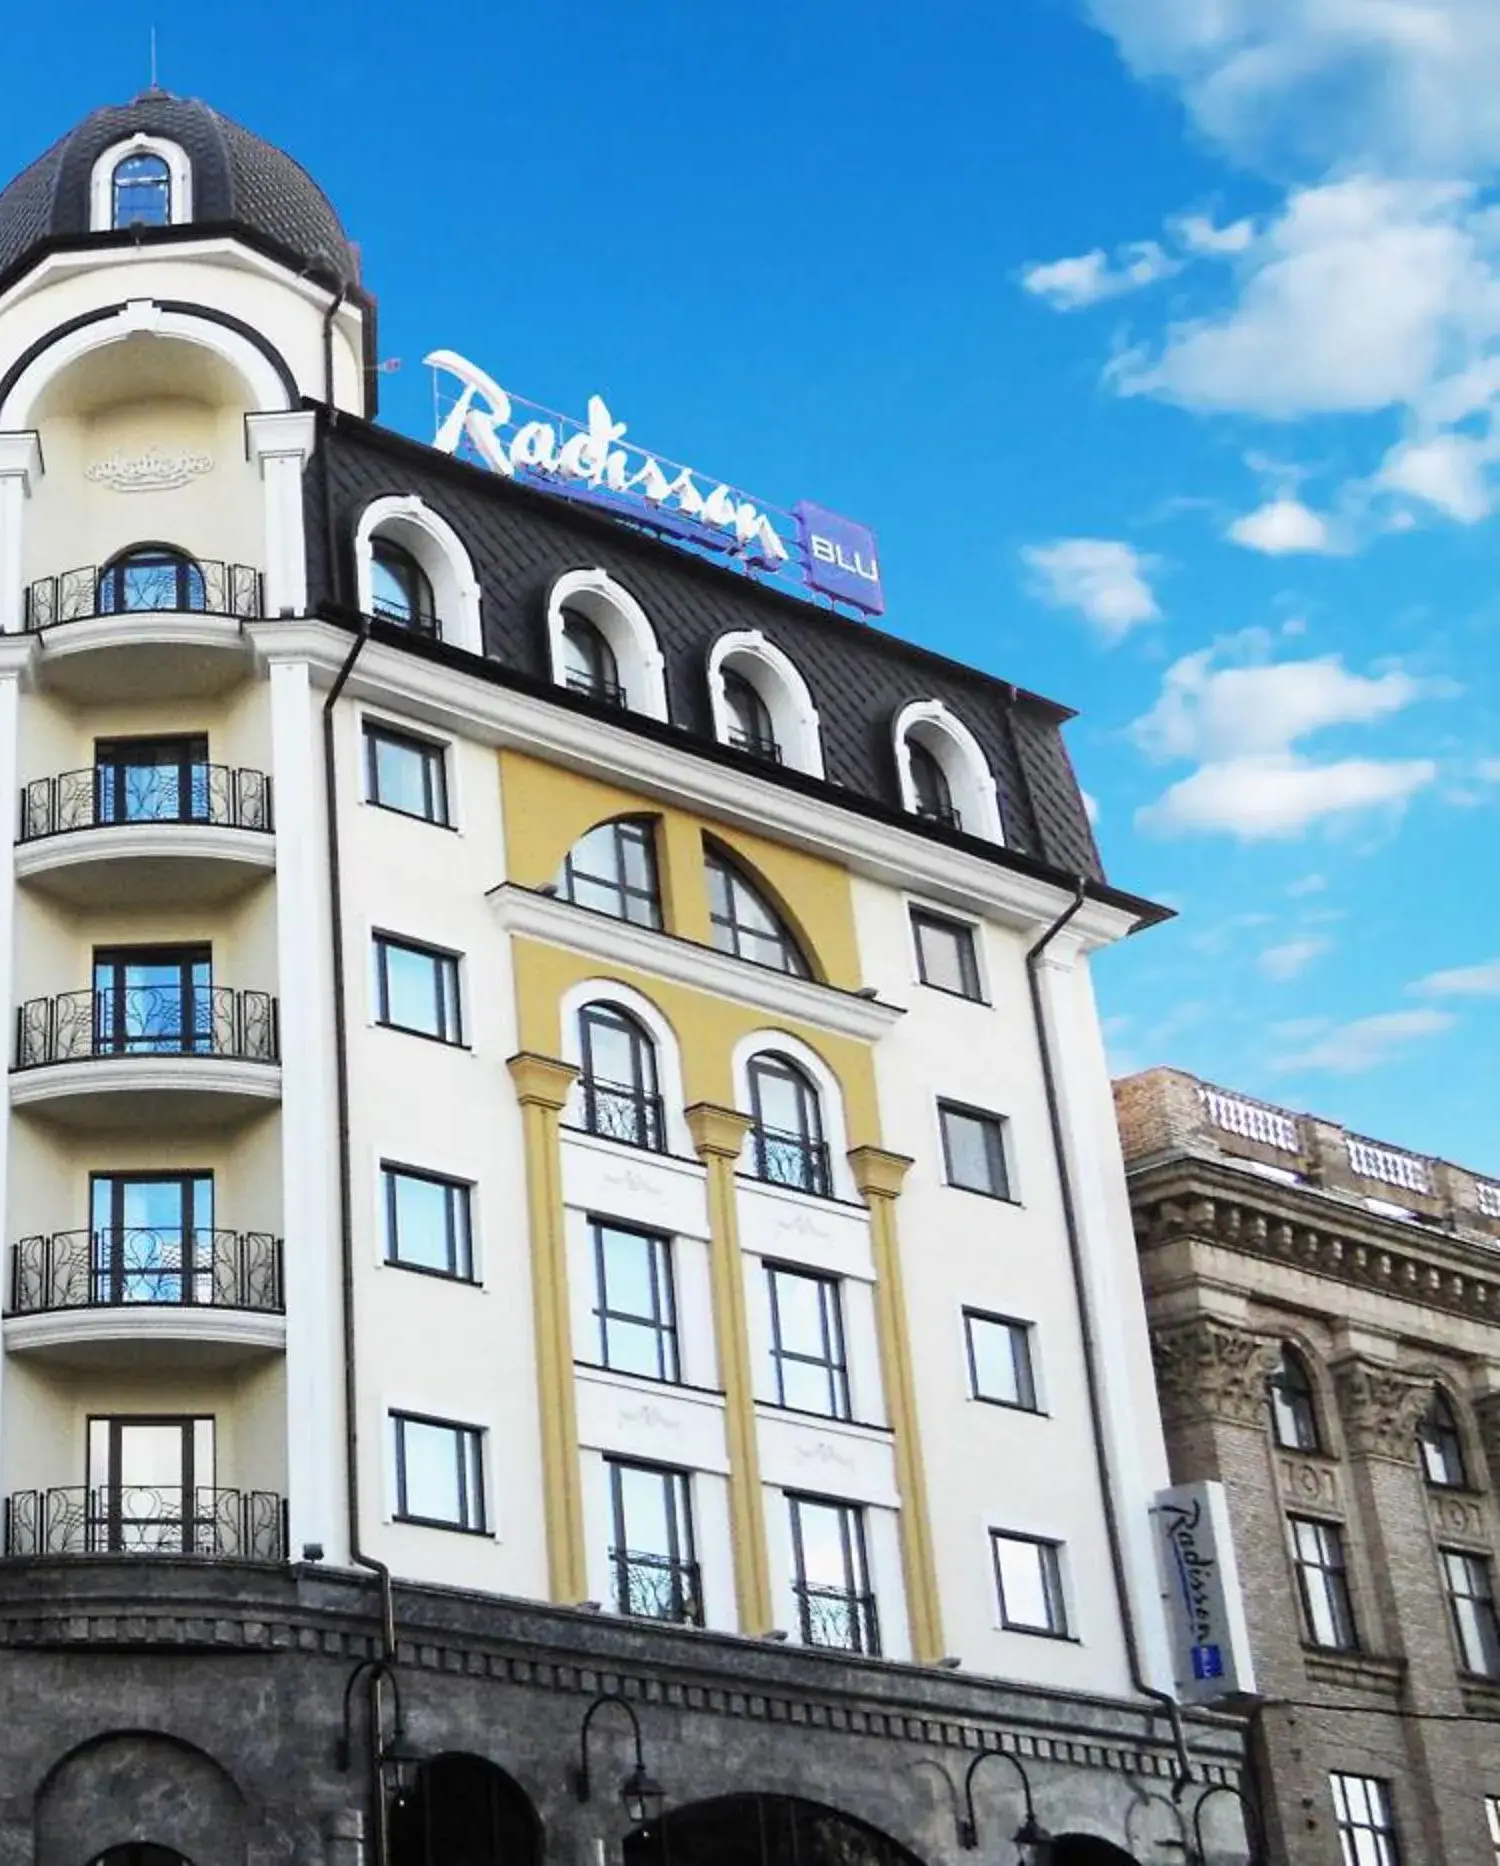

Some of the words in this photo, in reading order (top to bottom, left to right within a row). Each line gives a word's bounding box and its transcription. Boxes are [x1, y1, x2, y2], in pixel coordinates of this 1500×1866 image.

[422, 349, 789, 562] Radisson
[811, 534, 878, 582] BLU
[1148, 1498, 1214, 1644] Radisson
